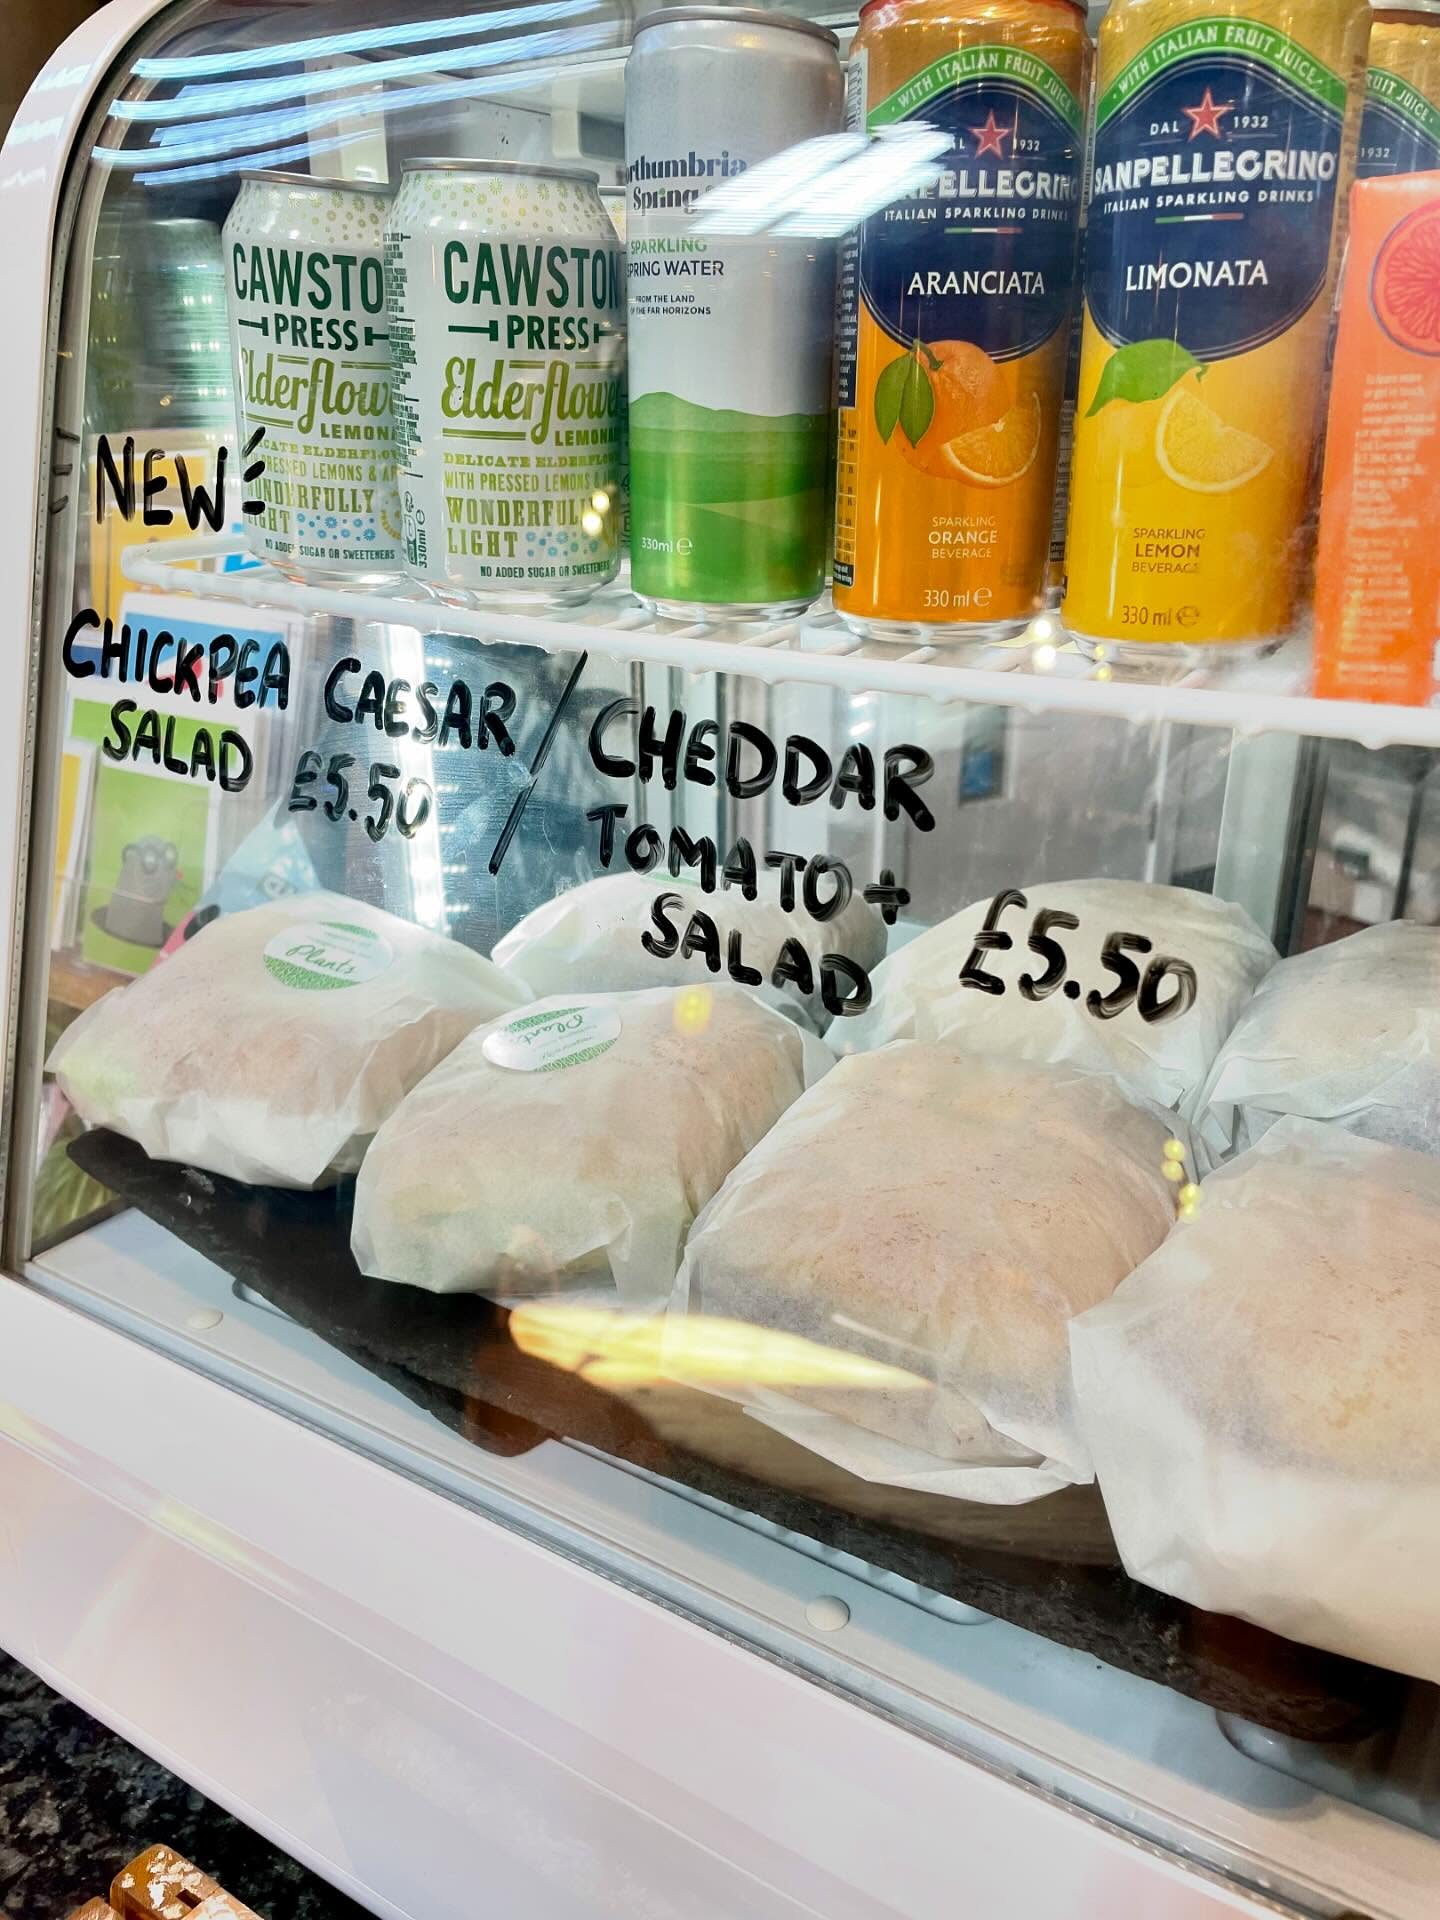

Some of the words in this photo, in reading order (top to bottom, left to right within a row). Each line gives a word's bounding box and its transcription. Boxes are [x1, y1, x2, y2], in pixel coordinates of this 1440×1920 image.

[1119, 61, 1150, 93] WITH
[1152, 26, 1219, 62] ITALIAN
[1225, 25, 1275, 52] FRUIT
[1275, 42, 1317, 86] JUICE
[898, 75, 934, 107] WITH
[937, 53, 999, 81] ITALIAN
[1005, 54, 1044, 80] FRUIT
[1397, 89, 1429, 121] JUICE
[1150, 122, 1179, 136] DAL
[1233, 115, 1269, 129] 1932
[1361, 147, 1390, 159] 1932
[1094, 150, 1336, 195] SANPELLEGRINO
[633, 186, 699, 216] Spring
[1104, 198, 1149, 214] ITALIAN
[1156, 191, 1249, 208] SPARKLING
[1258, 190, 1314, 203] DRINKS
[884, 208, 937, 221] ITALIAN
[945, 206, 1027, 219] SPARKLING
[631, 238, 708, 255] SPARKLING
[444, 240, 619, 310] CAWSTON
[664, 260, 725, 276] WATER
[1126, 259, 1268, 291] LIMONATA
[907, 271, 1045, 296] ARANCIATA
[654, 295, 668, 303] THE
[671, 295, 695, 303] LAND
[662, 307, 711, 315] HORIZONS
[274, 313, 359, 351] PRESS
[507, 314, 590, 350] PRESS
[444, 452, 531, 468] DELICATE
[97, 435, 228, 532] NEW
[313, 463, 363, 482] LEMONS
[369, 465, 377, 482] &
[445, 471, 475, 490] WITH
[480, 473, 539, 493] PRESSED
[545, 471, 591, 492] LEMONS
[932, 516, 996, 528] SPARKLING
[447, 528, 518, 558] LIGHT
[928, 530, 998, 544] ORANGE
[1133, 528, 1206, 540] SPARKLING
[265, 538, 273, 549] NO
[300, 545, 325, 558] SUGAR
[329, 547, 340, 559] OR
[343, 548, 395, 560] SWEETENERS
[417, 529, 428, 568] 330ml
[932, 547, 992, 559] BEVERAGE
[1135, 543, 1200, 558] LEMON
[480, 565, 492, 577] NO
[496, 566, 524, 578] ADDED
[528, 566, 556, 578] SUGAR
[559, 565, 569, 577] OR
[923, 590, 949, 607] 330
[953, 589, 970, 607] ml
[1122, 605, 1149, 625] 330
[1153, 608, 1172, 626] ml
[62, 609, 291, 711] CHICKPEA
[324, 657, 517, 757] CAESAR
[102, 699, 254, 793] SALAD
[288, 751, 433, 843] £5.50
[588, 698, 936, 832] CHEDDAR
[286, 944, 357, 974] Plants
[641, 892, 872, 1018] SALAD
[959, 889, 1198, 1025] £5.50
